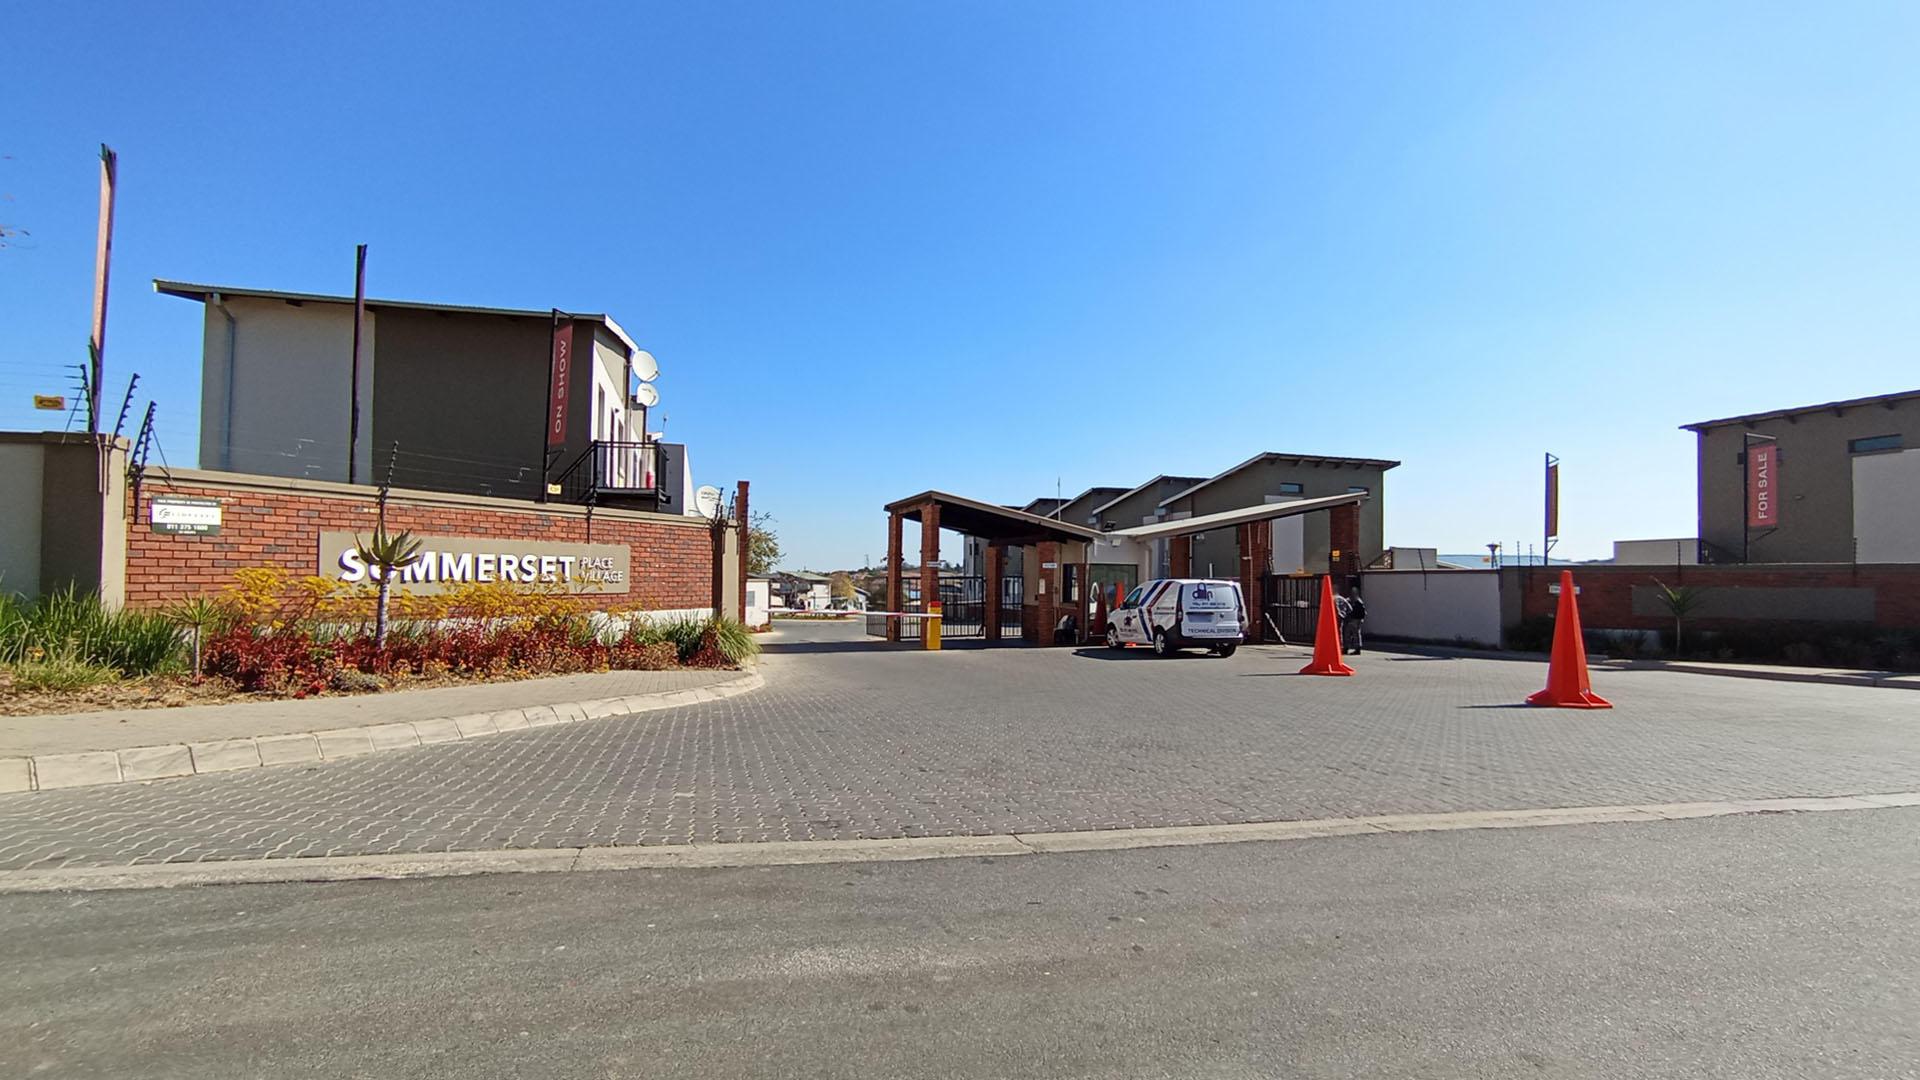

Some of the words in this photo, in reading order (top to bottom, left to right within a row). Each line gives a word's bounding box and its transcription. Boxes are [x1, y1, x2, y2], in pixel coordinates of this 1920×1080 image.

[557, 340, 567, 400] SHOW
[555, 404, 563, 434] ON
[1758, 452, 1768, 488] SALE
[1758, 491, 1768, 519] FOR
[581, 556, 614, 569] PLACE
